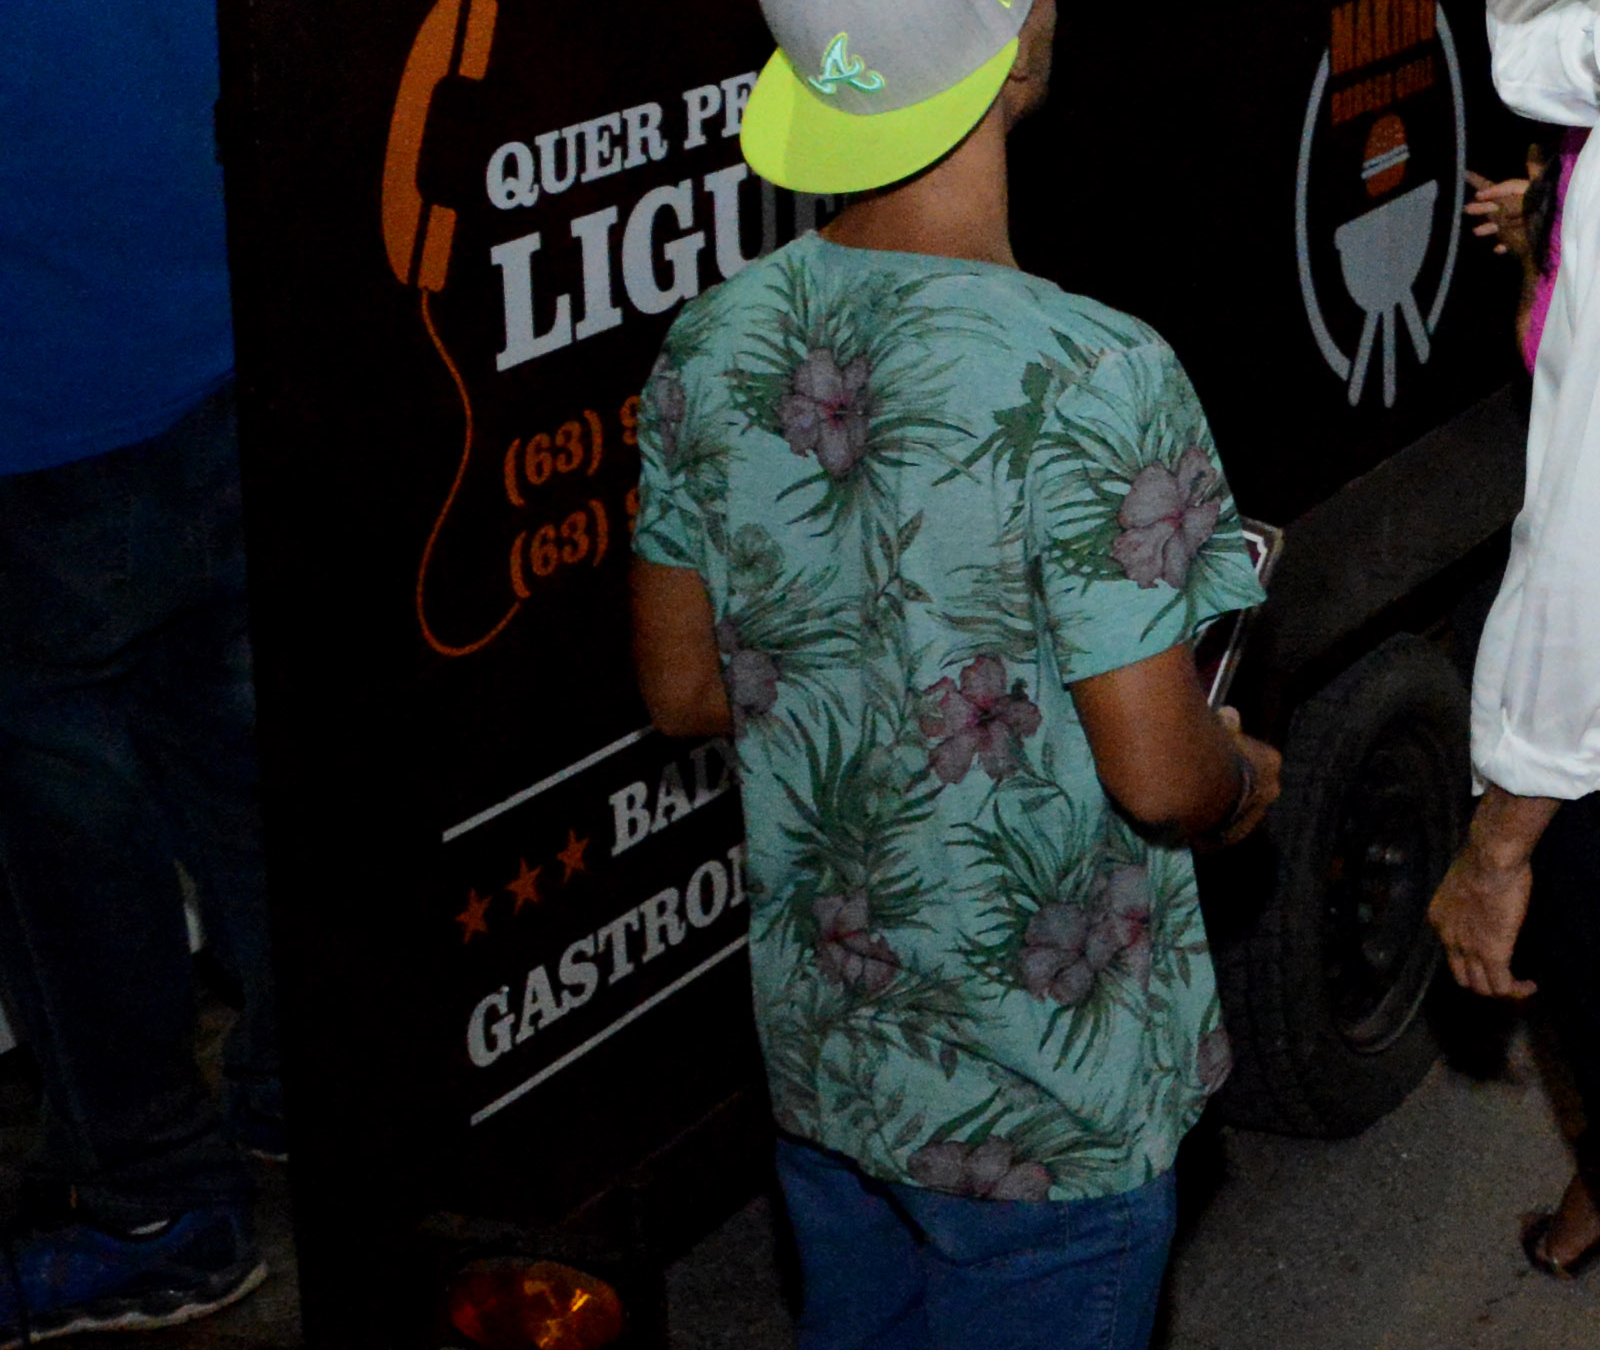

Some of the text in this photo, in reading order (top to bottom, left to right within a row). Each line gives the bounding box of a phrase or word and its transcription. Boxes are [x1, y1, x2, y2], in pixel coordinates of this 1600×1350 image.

[486, 102, 668, 210] QUER
[504, 410, 604, 506] (63)
[510, 499, 609, 598] (63)
